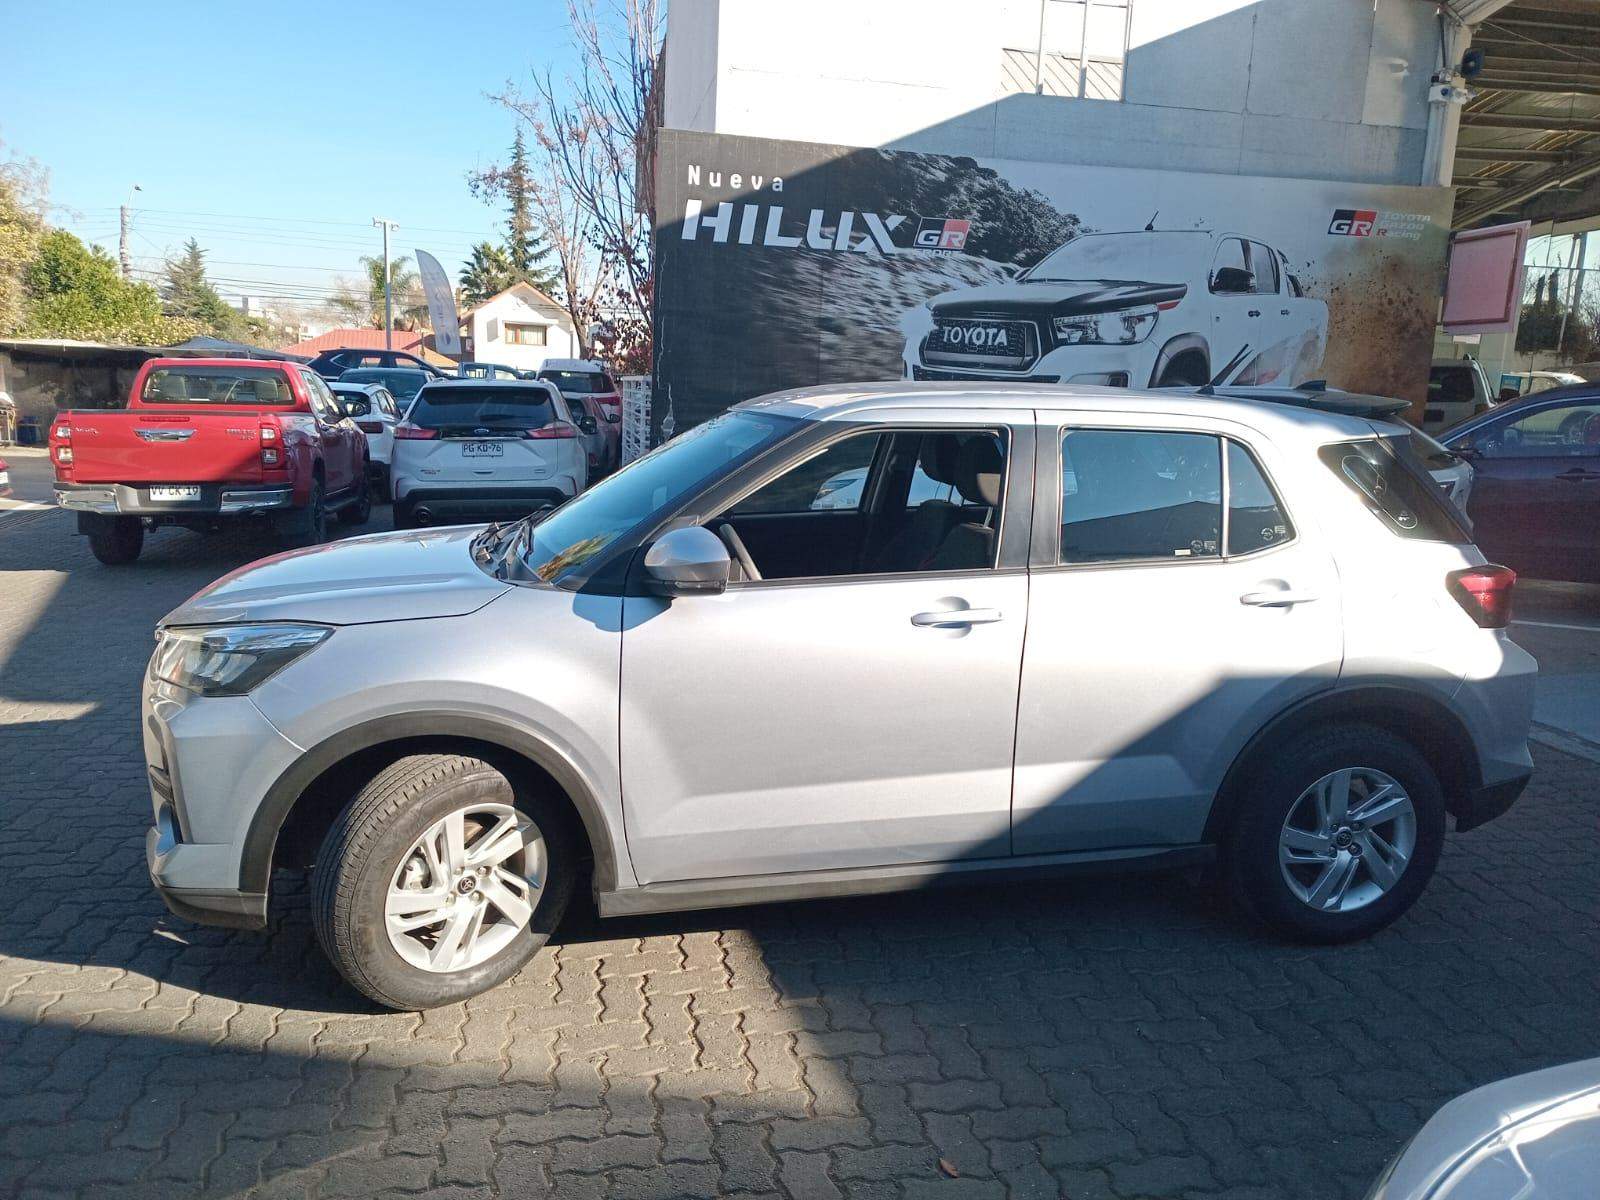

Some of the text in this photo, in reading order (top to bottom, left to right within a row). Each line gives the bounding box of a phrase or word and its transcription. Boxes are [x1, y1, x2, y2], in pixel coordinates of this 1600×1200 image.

[687, 164, 784, 192] Nueva
[681, 198, 965, 255] HILUX GR
[1381, 211, 1431, 222] TOYOTA
[1329, 219, 1372, 237] GR
[942, 325, 1008, 346] TOYOTA
